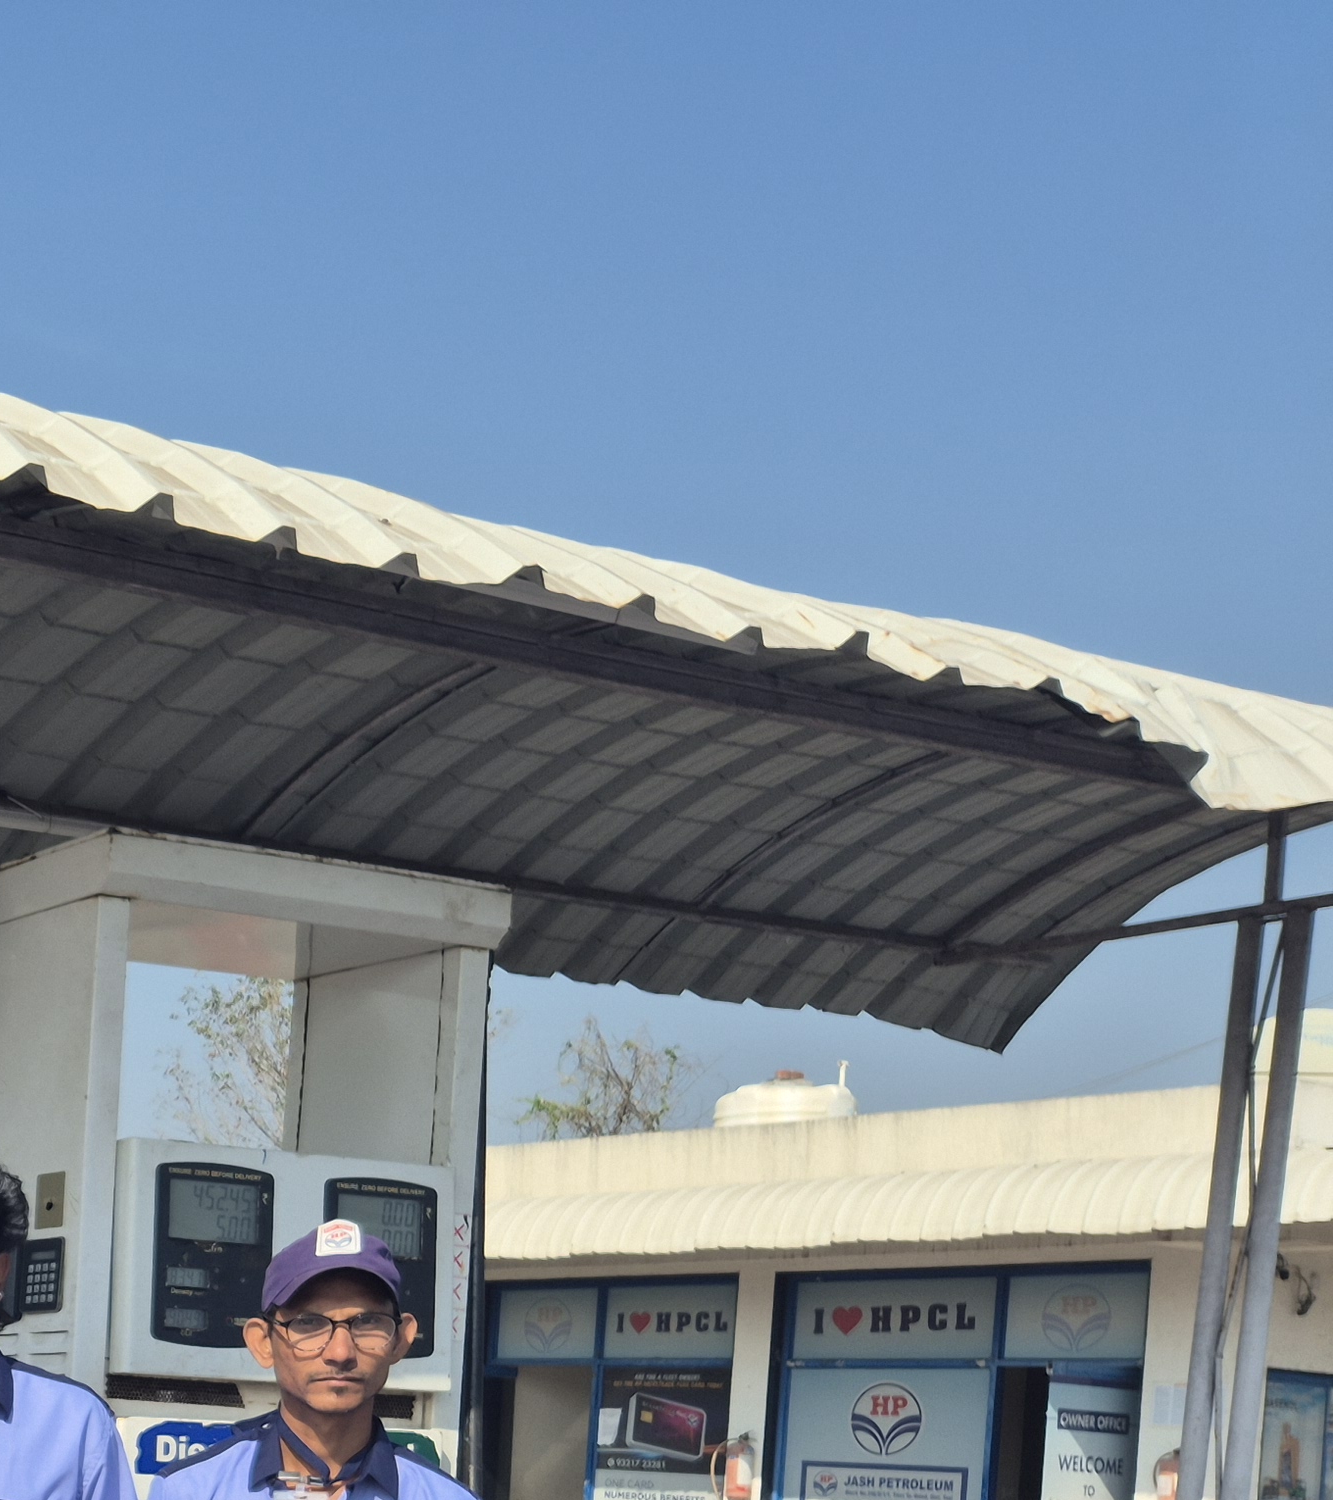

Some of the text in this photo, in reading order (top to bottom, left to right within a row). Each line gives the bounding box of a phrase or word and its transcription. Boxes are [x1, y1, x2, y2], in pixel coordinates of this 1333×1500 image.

[361, 1183, 376, 1192] ZERO
[377, 1185, 399, 1194] BEFORE
[655, 1311, 729, 1333] HPCL
[813, 1303, 976, 1335] I HPCL
[869, 1394, 909, 1417] HP
[1060, 1411, 1127, 1432] OWNER OFFICE
[155, 1434, 217, 1464] Die
[1058, 1453, 1124, 1476] WELCOME
[604, 1478, 655, 1490] ONE CARD
[844, 1475, 954, 1492] JASH PETROLEUM
[1083, 1484, 1095, 1497] TO
